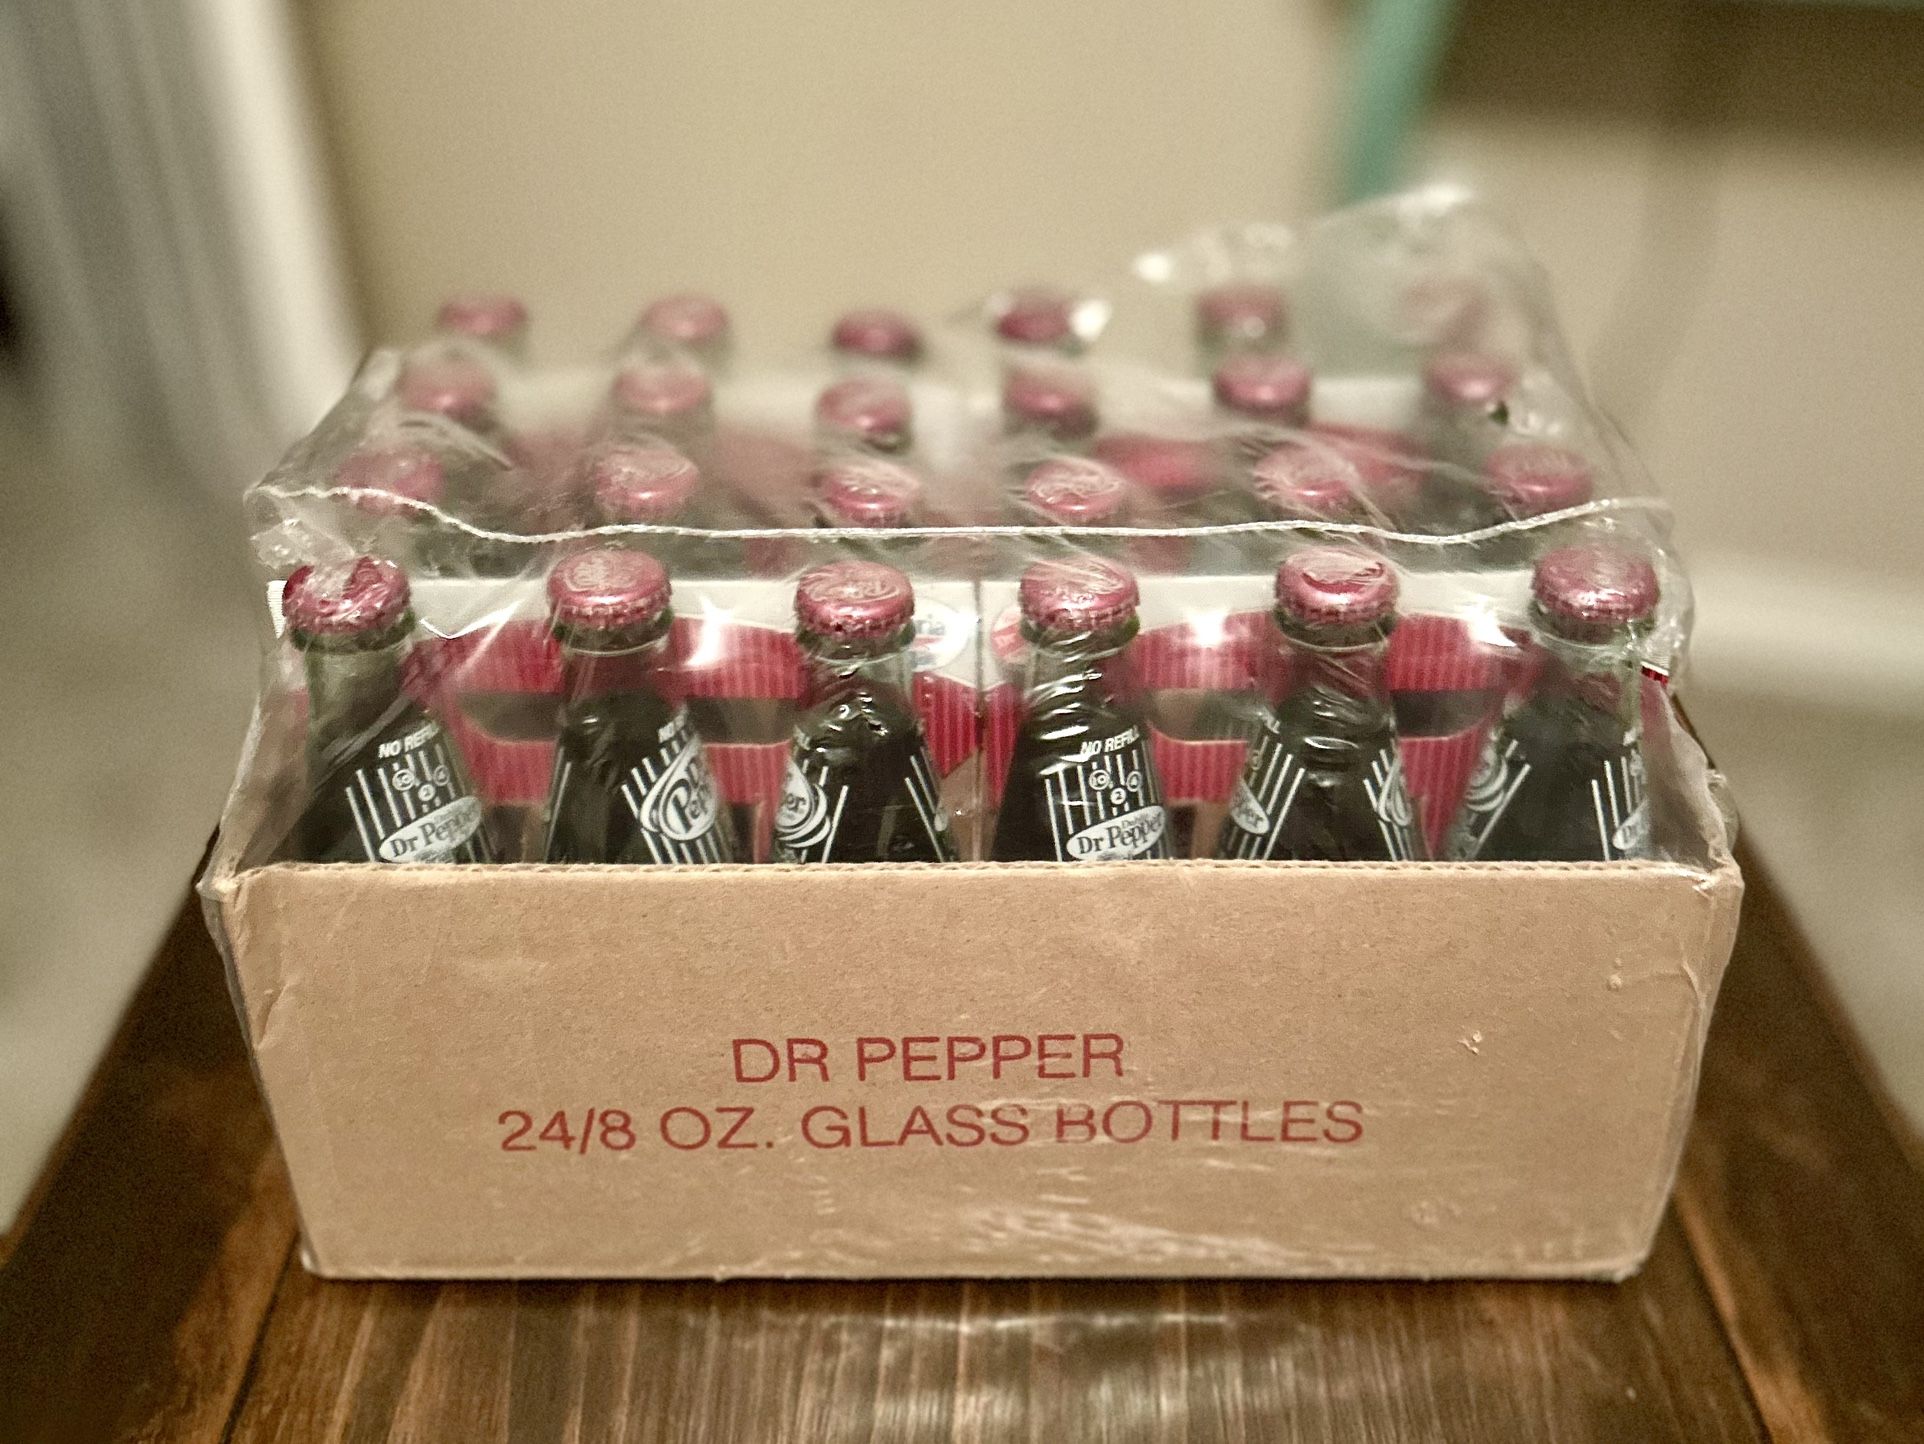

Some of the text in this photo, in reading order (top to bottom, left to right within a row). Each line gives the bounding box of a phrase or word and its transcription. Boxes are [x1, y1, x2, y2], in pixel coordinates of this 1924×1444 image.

[378, 739, 402, 759] NO
[1080, 740, 1102, 756] NO
[390, 836, 418, 858] Dr
[1077, 836, 1104, 855] Dr
[731, 1033, 1125, 1083] DR PEPPER
[498, 1099, 1364, 1154] 24/8 OZ. GLASS BOTTLES
